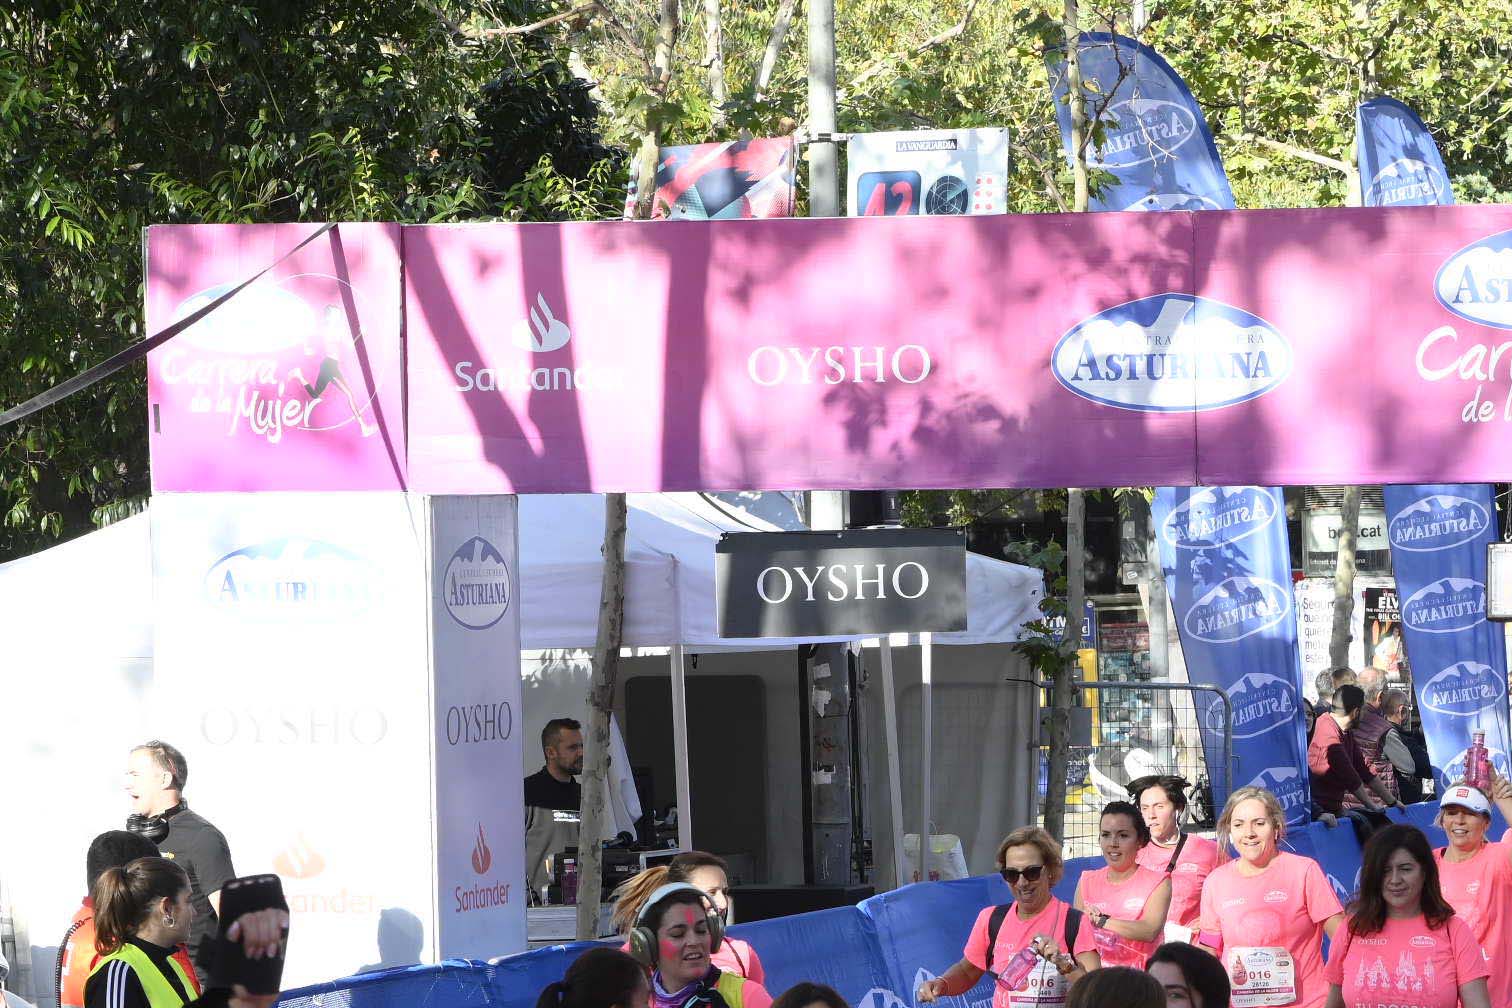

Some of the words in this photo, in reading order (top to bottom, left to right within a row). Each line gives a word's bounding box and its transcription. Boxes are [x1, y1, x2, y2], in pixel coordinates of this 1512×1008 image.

[907, 139, 957, 152] VANGUARDIA
[747, 344, 932, 387] OYSHO
[226, 382, 322, 444] Mujer
[1461, 384, 1495, 424] de
[449, 572, 507, 606] ASTURIANA
[755, 561, 931, 605] OYSHO
[1378, 597, 1399, 609] ELV
[200, 705, 389, 746] OYSHO
[446, 701, 512, 747] OYSHO
[454, 882, 511, 913] Santander
[1248, 970, 1272, 980] 016
